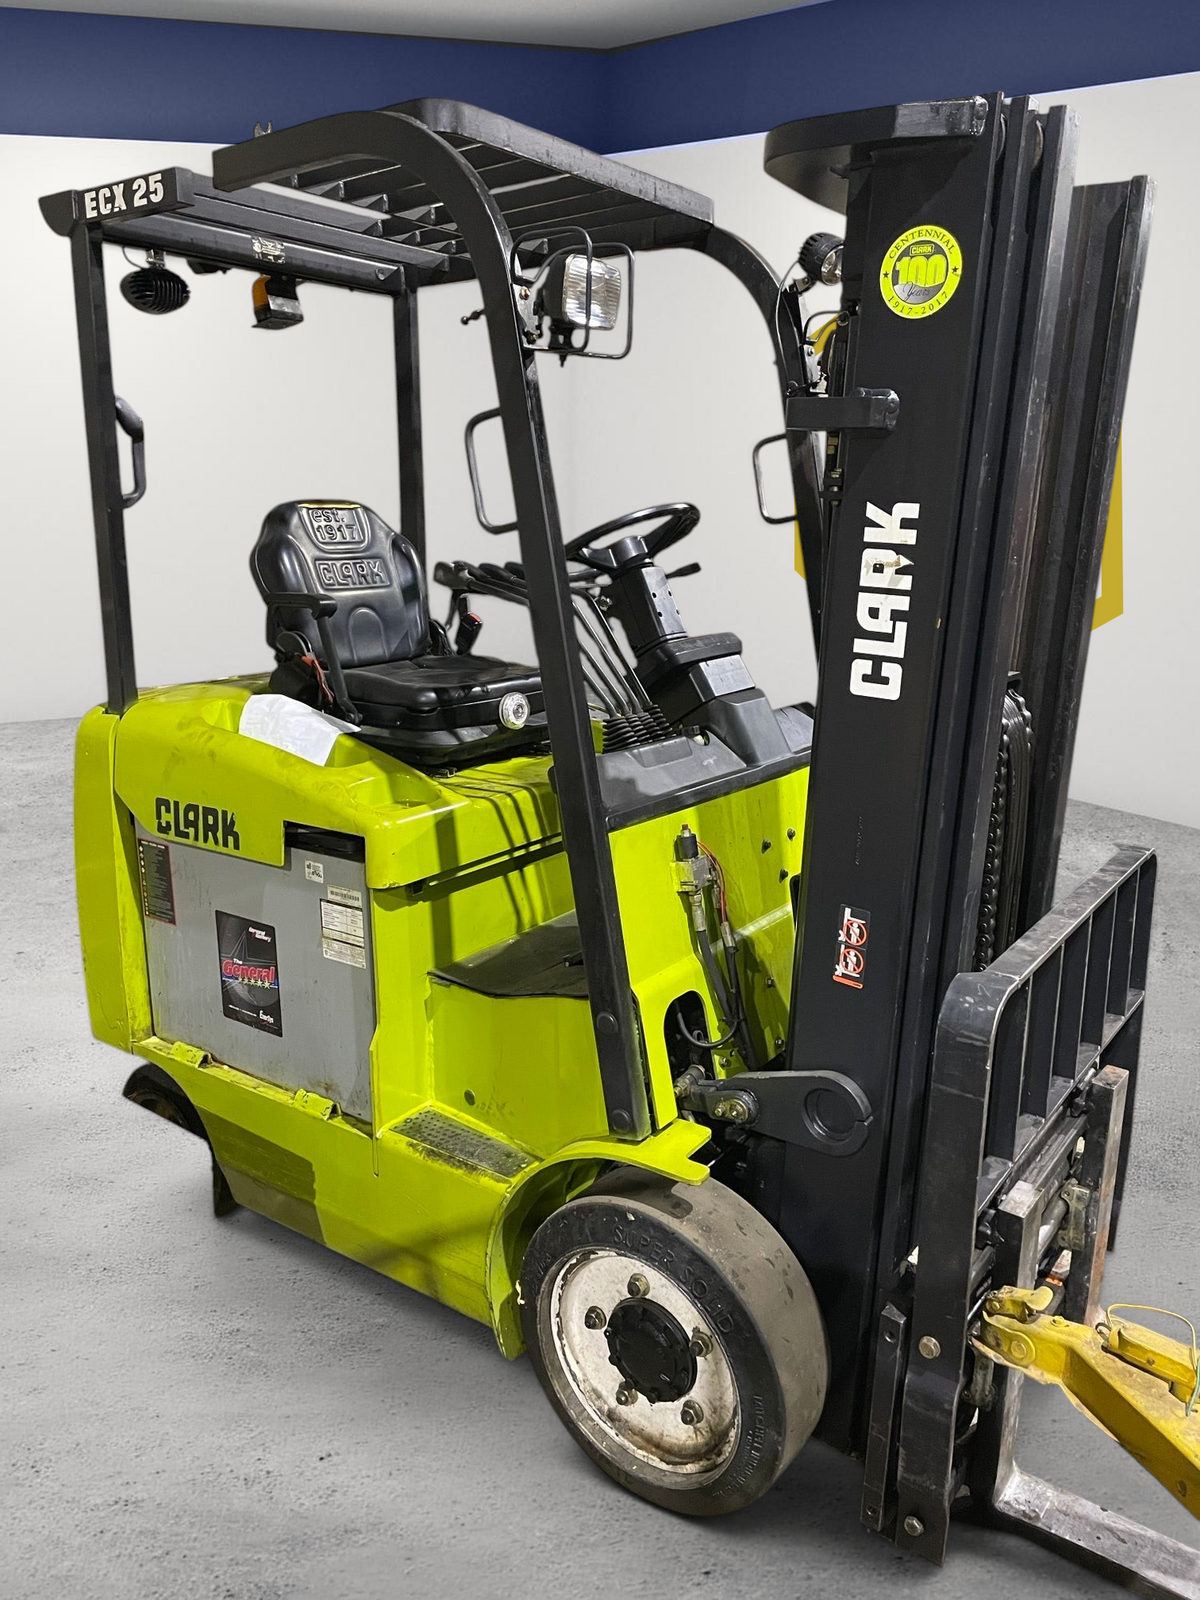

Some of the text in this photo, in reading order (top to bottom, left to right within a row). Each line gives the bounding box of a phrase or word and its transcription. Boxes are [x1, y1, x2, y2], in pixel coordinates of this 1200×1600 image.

[84, 172, 164, 219] ECX 25
[889, 228, 955, 259] CENTENNIAL
[911, 245, 934, 254] CLARK
[895, 254, 947, 287] 100
[888, 291, 948, 315] 1917-2017
[902, 280, 930, 302] Years
[312, 508, 345, 523] est.
[315, 524, 359, 541] 1917
[319, 561, 386, 586] CLARK
[849, 501, 920, 701] CLARK
[155, 797, 240, 850] CLARK
[222, 959, 276, 983] General
[232, 957, 243, 965] The
[614, 1224, 676, 1266] SUPER
